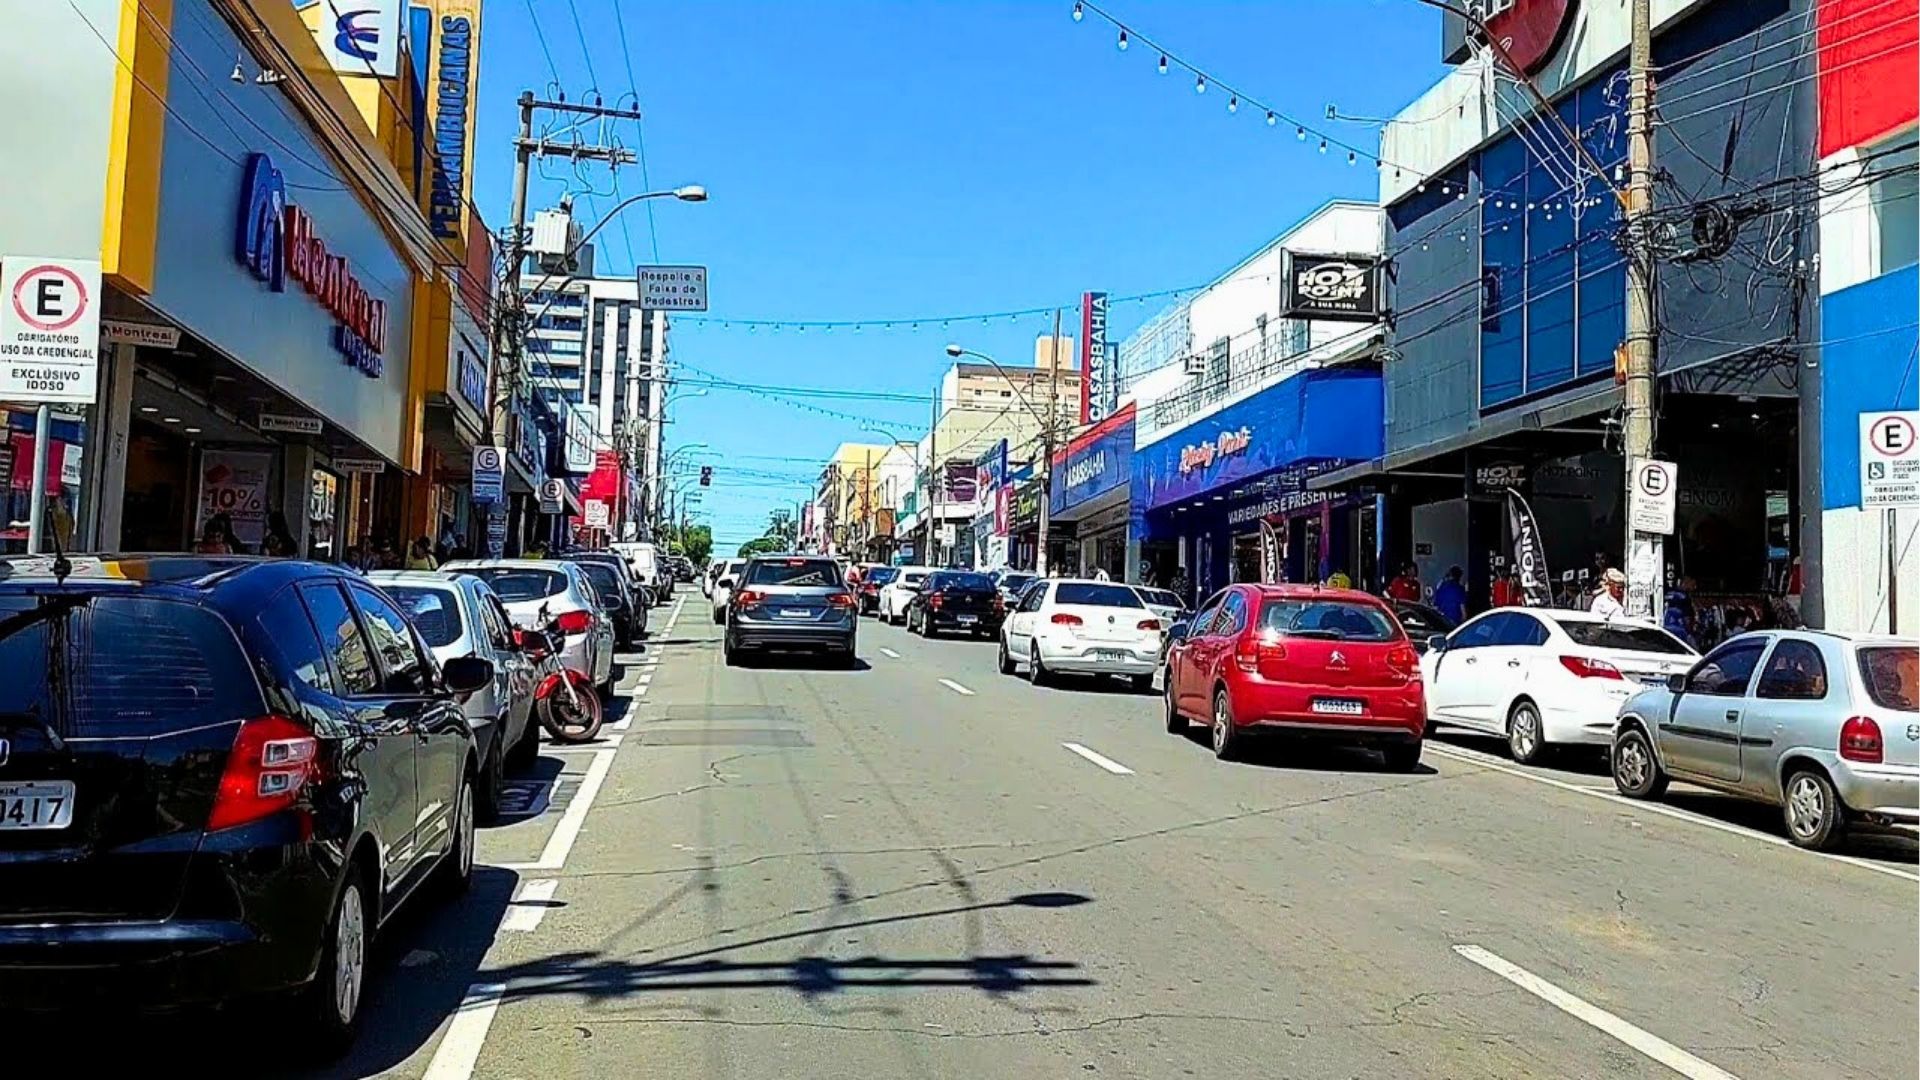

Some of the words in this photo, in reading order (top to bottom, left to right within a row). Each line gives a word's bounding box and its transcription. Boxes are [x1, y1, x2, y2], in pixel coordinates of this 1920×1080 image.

[431, 15, 471, 239] PERNAMBUCANAS
[641, 271, 691, 283] Respeite
[1298, 269, 1364, 286] HOT
[649, 284, 677, 293] Faixa
[682, 285, 697, 293] de
[1298, 285, 1367, 299] POINT
[37, 279, 63, 316] E
[644, 296, 701, 305] Pedestres
[112, 326, 172, 340] Montreal
[1, 345, 20, 355] USO
[22, 346, 34, 356] DA
[37, 346, 94, 359] CREDENCIAL
[26, 380, 64, 391] IDOSO
[1885, 424, 1902, 448] E
[485, 452, 494, 465] E
[1477, 465, 1525, 478] HOT
[1477, 477, 1526, 486] POINT
[1646, 468, 1661, 490] E
[1228, 499, 1279, 525] VARIEDADES
[1280, 498, 1287, 511] E
[1519, 511, 1537, 588] POINT
